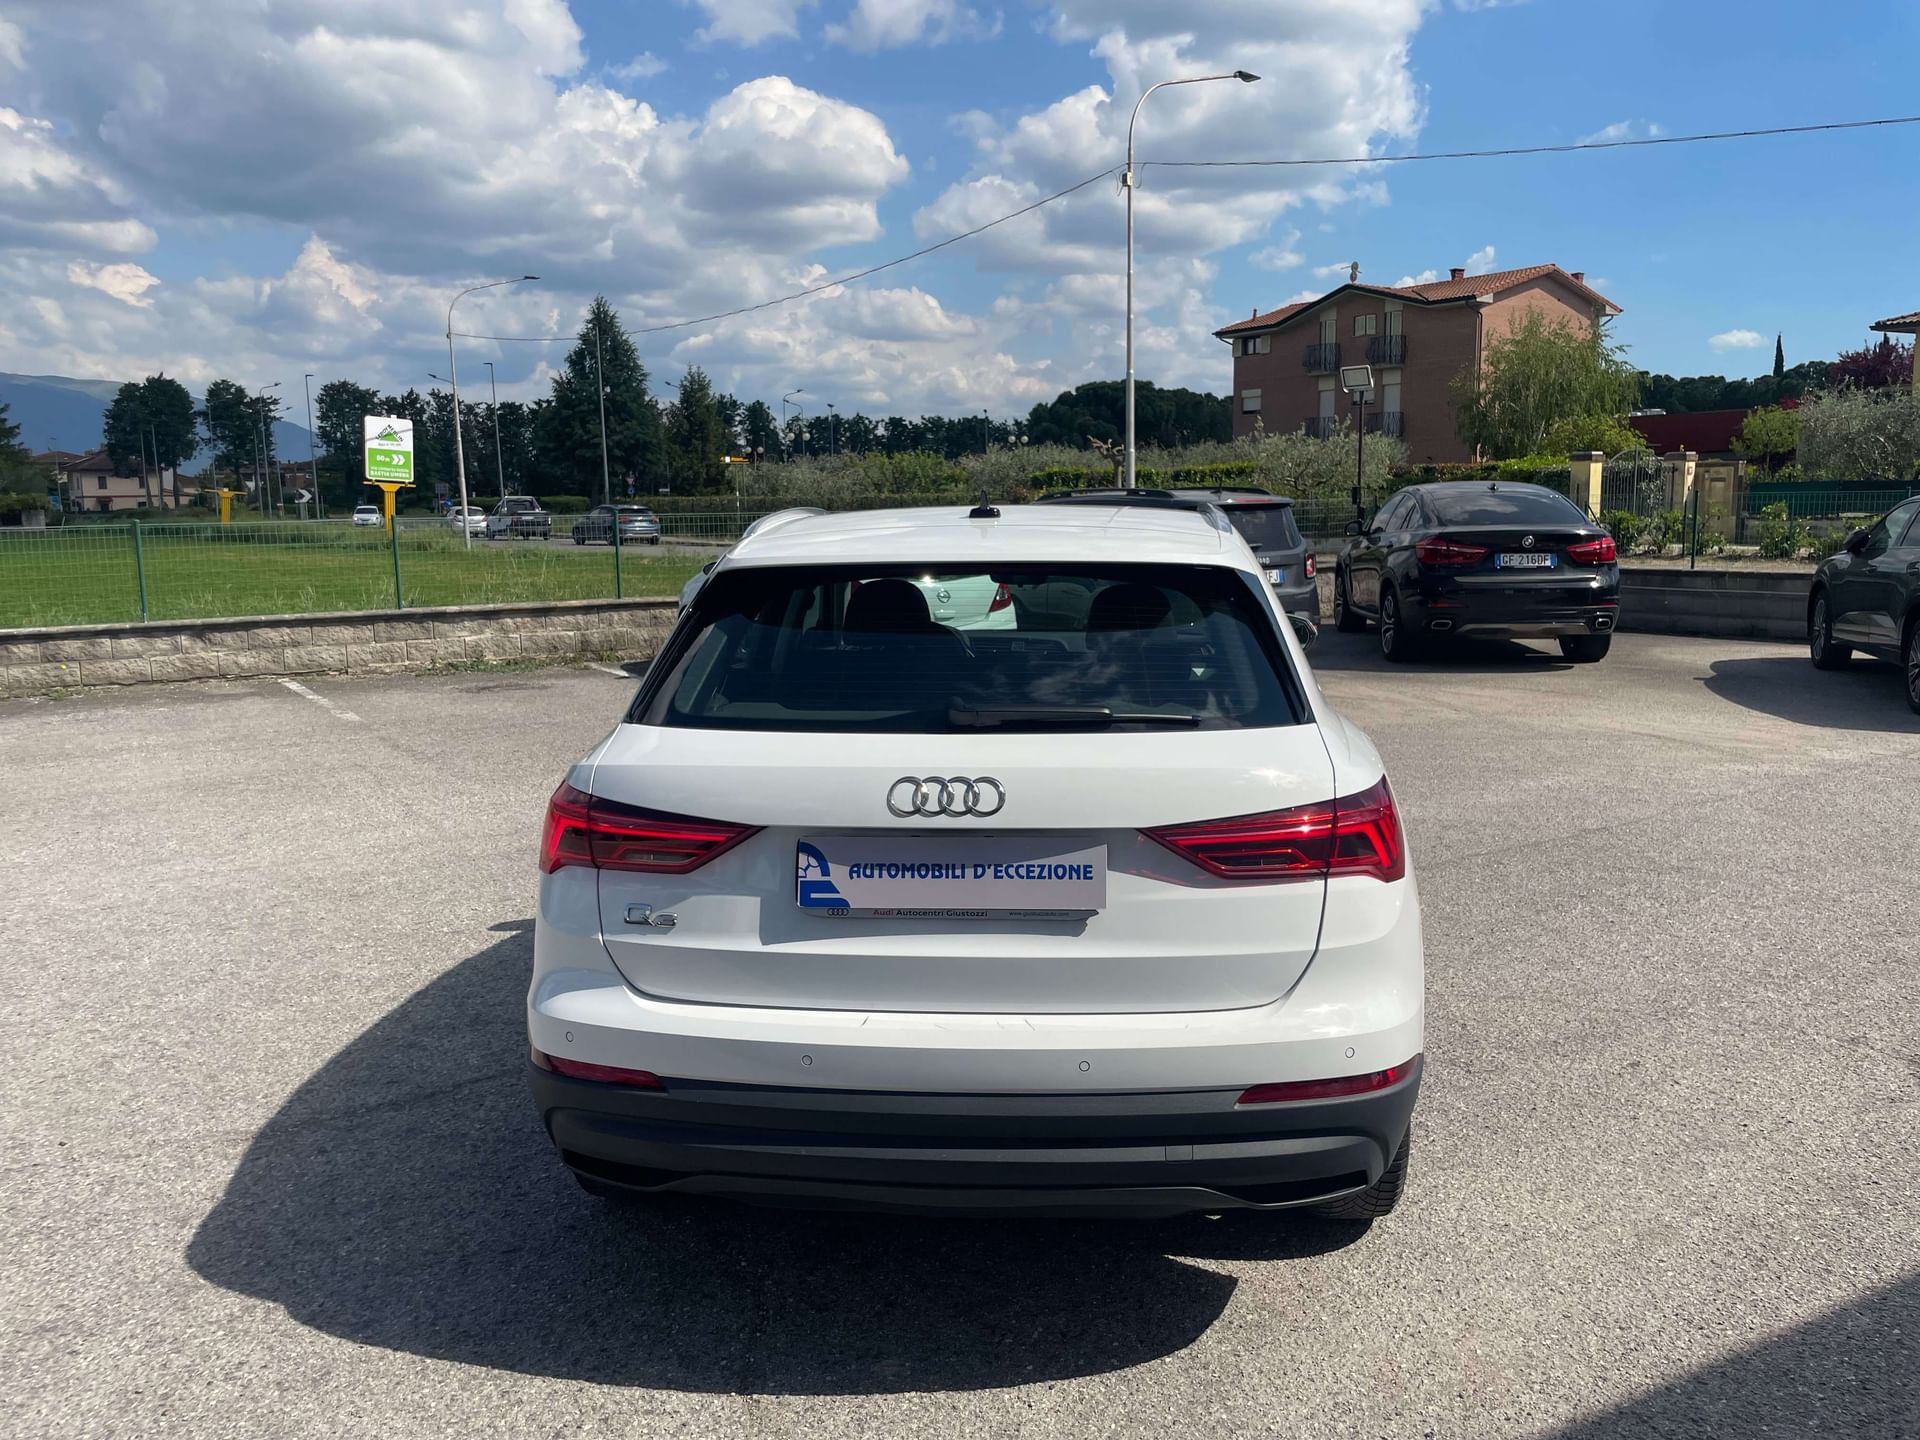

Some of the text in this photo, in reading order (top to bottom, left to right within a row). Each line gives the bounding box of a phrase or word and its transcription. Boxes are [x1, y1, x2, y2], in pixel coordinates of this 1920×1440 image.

[375, 424, 404, 442] LEROY MERLIN
[1518, 554, 1550, 565] 216DF
[848, 863, 1094, 881] AUTOMOBILI D'ECCEZIONE
[896, 909, 944, 917] Autocentri
